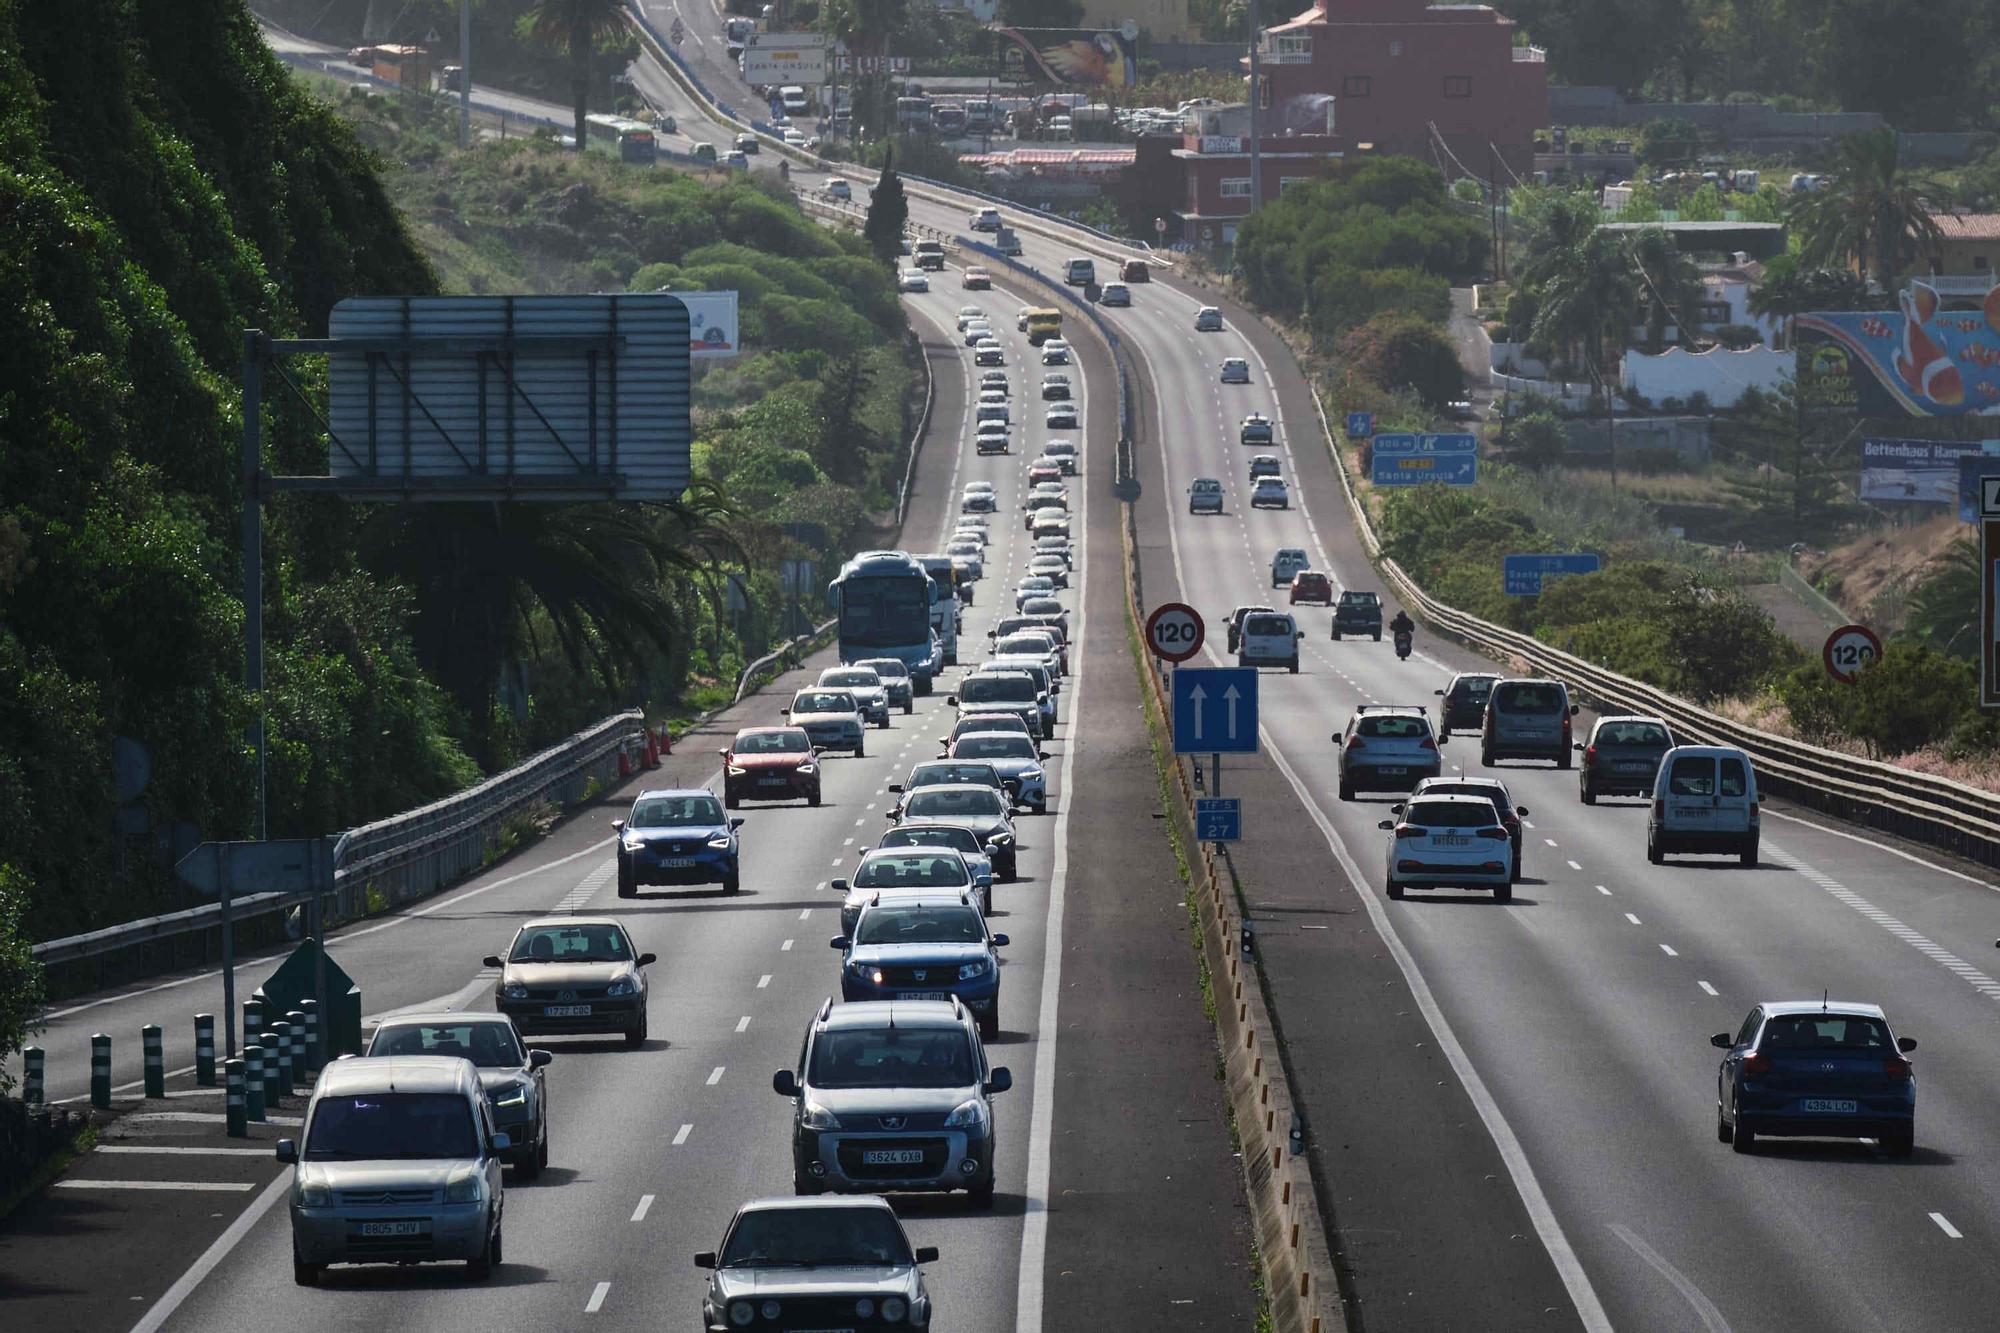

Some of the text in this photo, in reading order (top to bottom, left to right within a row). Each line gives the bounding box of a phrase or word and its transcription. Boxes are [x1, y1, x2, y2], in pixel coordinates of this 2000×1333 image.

[1155, 622, 1196, 643] 120
[1833, 644, 1875, 665] 120
[1208, 824, 1230, 838] 27
[870, 1151, 897, 1162] 3624
[365, 1223, 393, 1234] 8805
